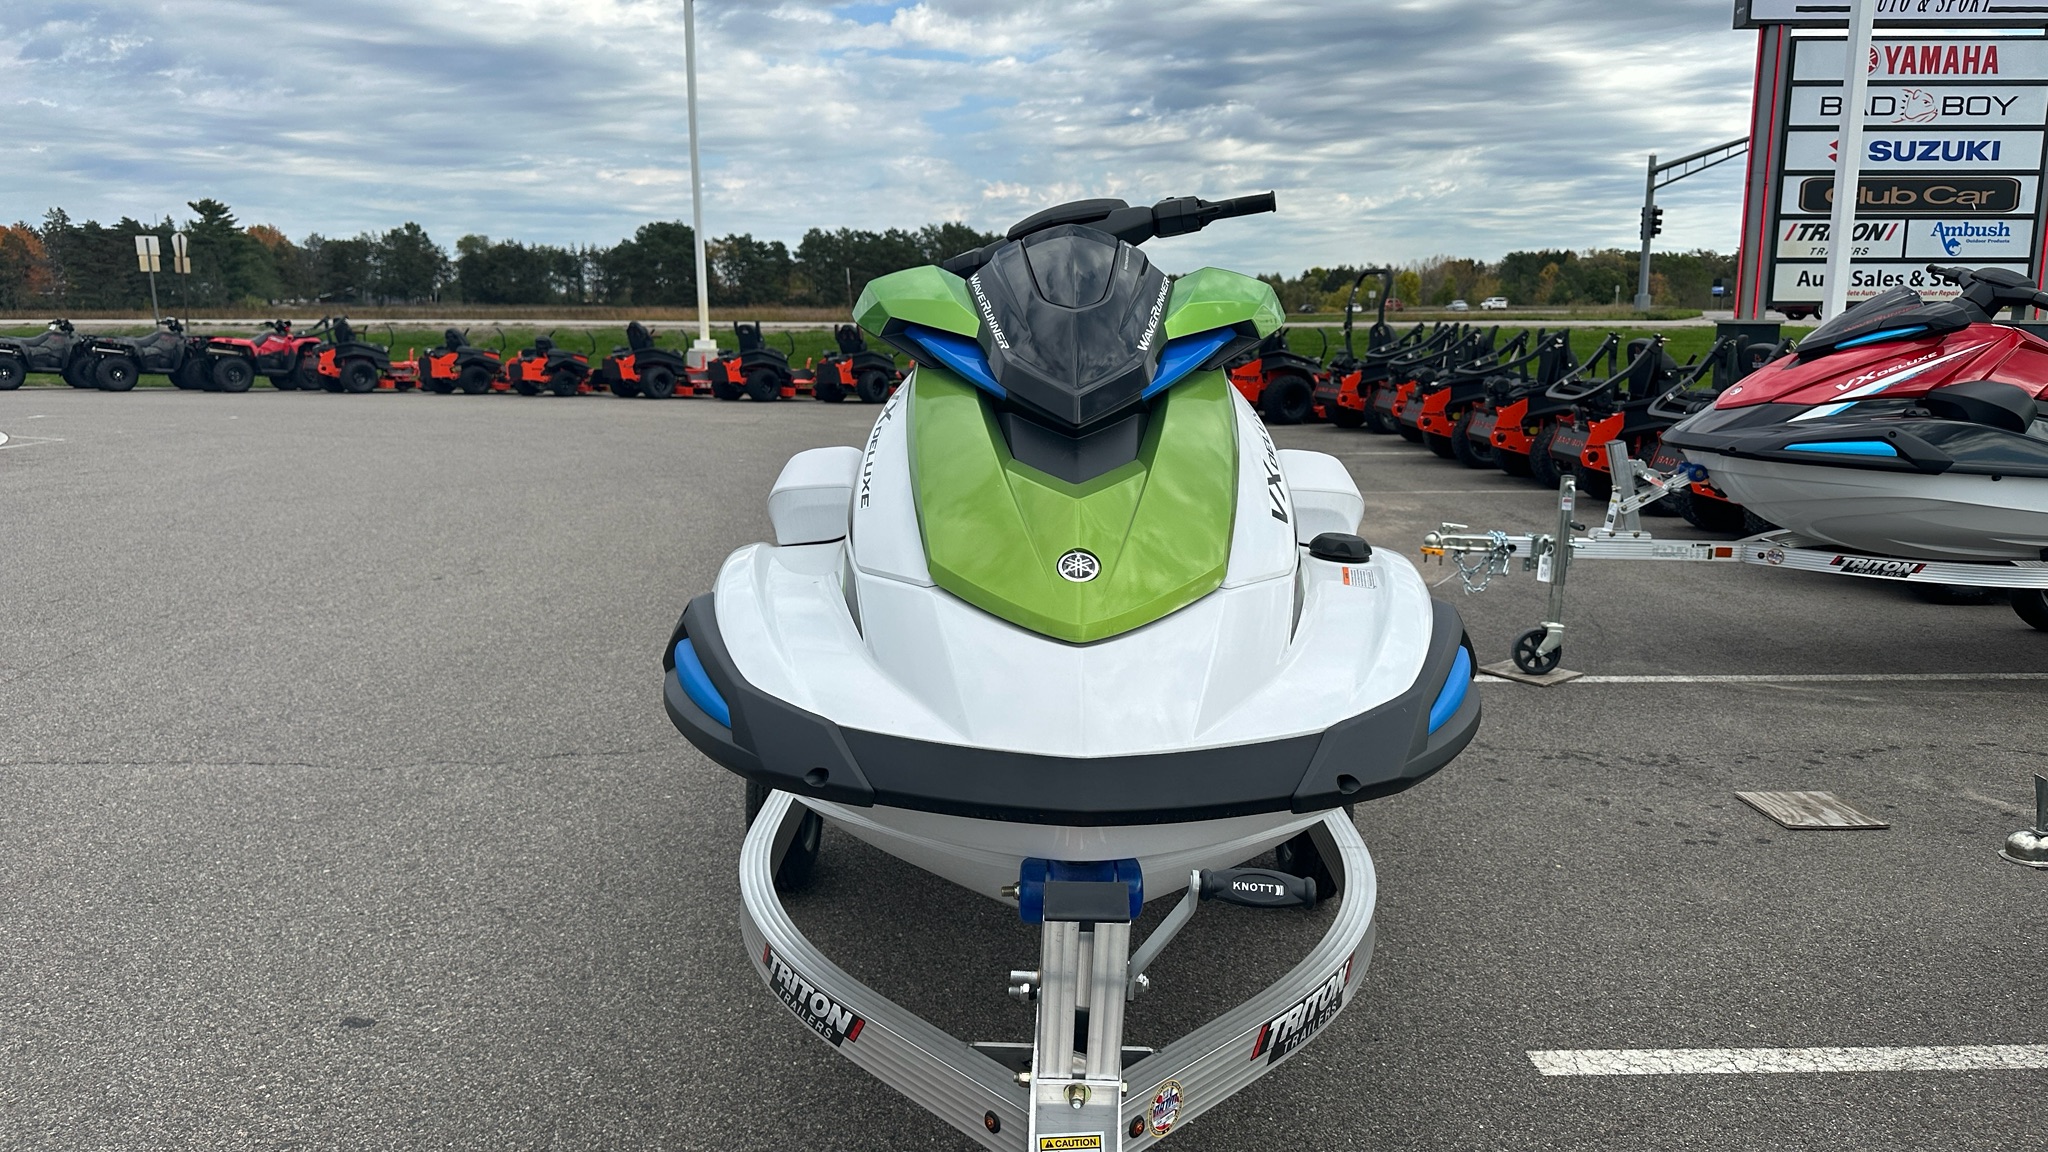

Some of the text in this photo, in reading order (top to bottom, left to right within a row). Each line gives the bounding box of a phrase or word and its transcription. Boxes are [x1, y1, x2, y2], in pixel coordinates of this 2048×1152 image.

[1884, 45, 1999, 75] YAMAHA
[1820, 96, 2018, 116] BD BOY
[1868, 140, 2001, 161] SUZUKI
[1923, 186, 1994, 204] Car
[1796, 223, 1889, 241] TRON
[1930, 221, 2010, 237] Ambush
[1851, 270, 1904, 287] Sales
[1909, 270, 1925, 287] &
[1938, 289, 1960, 298] Repair
[1840, 556, 1918, 574] TRITON
[1233, 881, 1274, 893] KNOTT
[769, 949, 853, 1035] TRITON
[779, 986, 833, 1039] TRAILERS
[1266, 960, 1350, 1051] TRITON
[1284, 1001, 1337, 1053] TRAILERS
[1055, 1138, 1097, 1148] CAUTION
